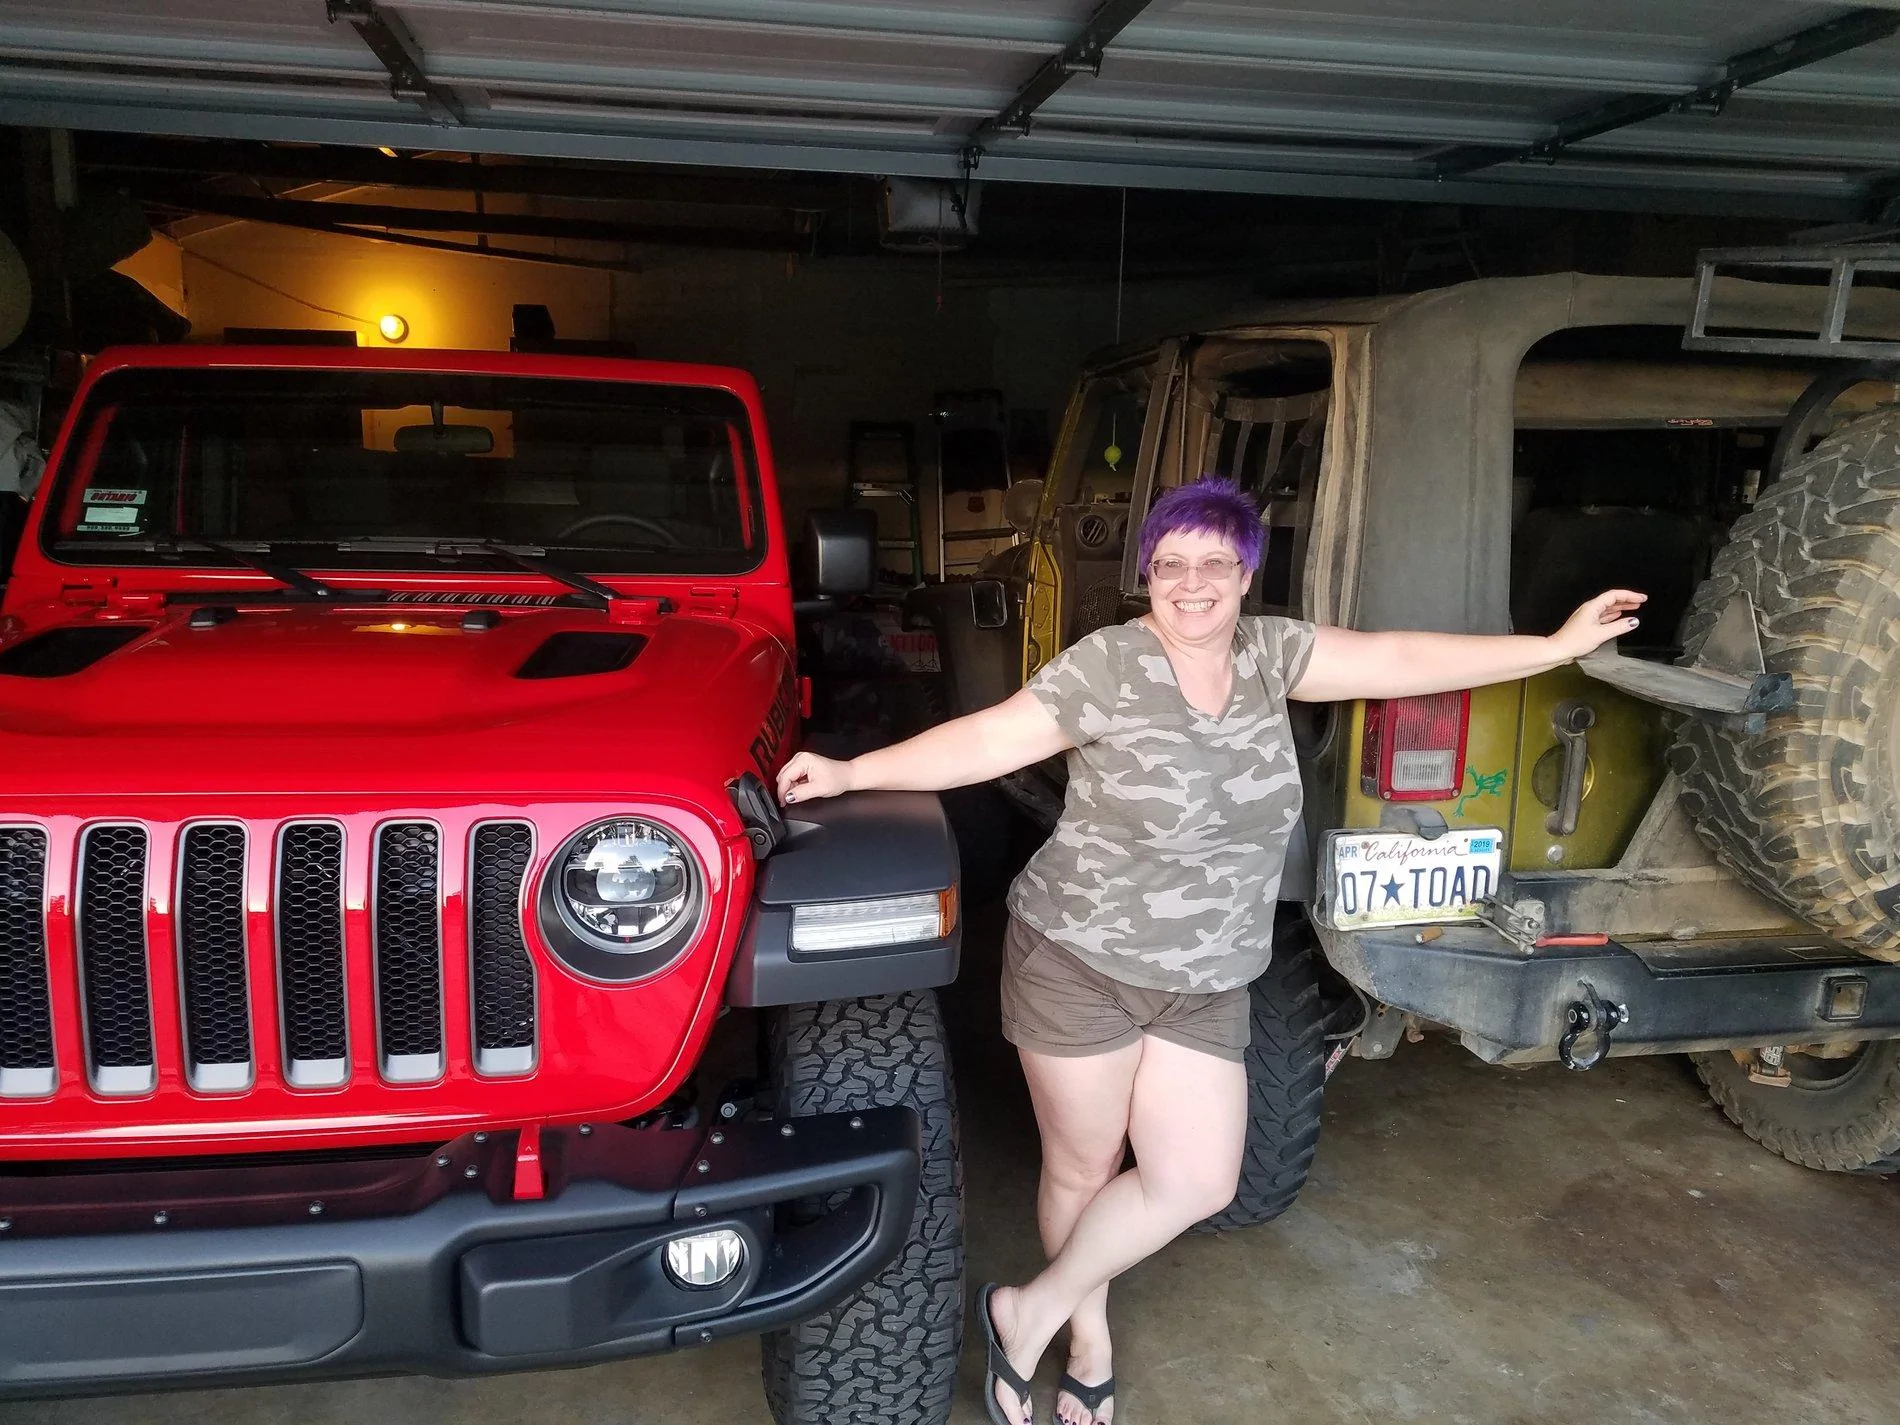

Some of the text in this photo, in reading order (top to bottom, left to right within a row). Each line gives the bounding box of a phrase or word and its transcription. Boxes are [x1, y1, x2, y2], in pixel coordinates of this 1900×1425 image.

[1473, 840, 1491, 848] 2019
[1339, 845, 1358, 859] APR
[1364, 840, 1468, 866] California
